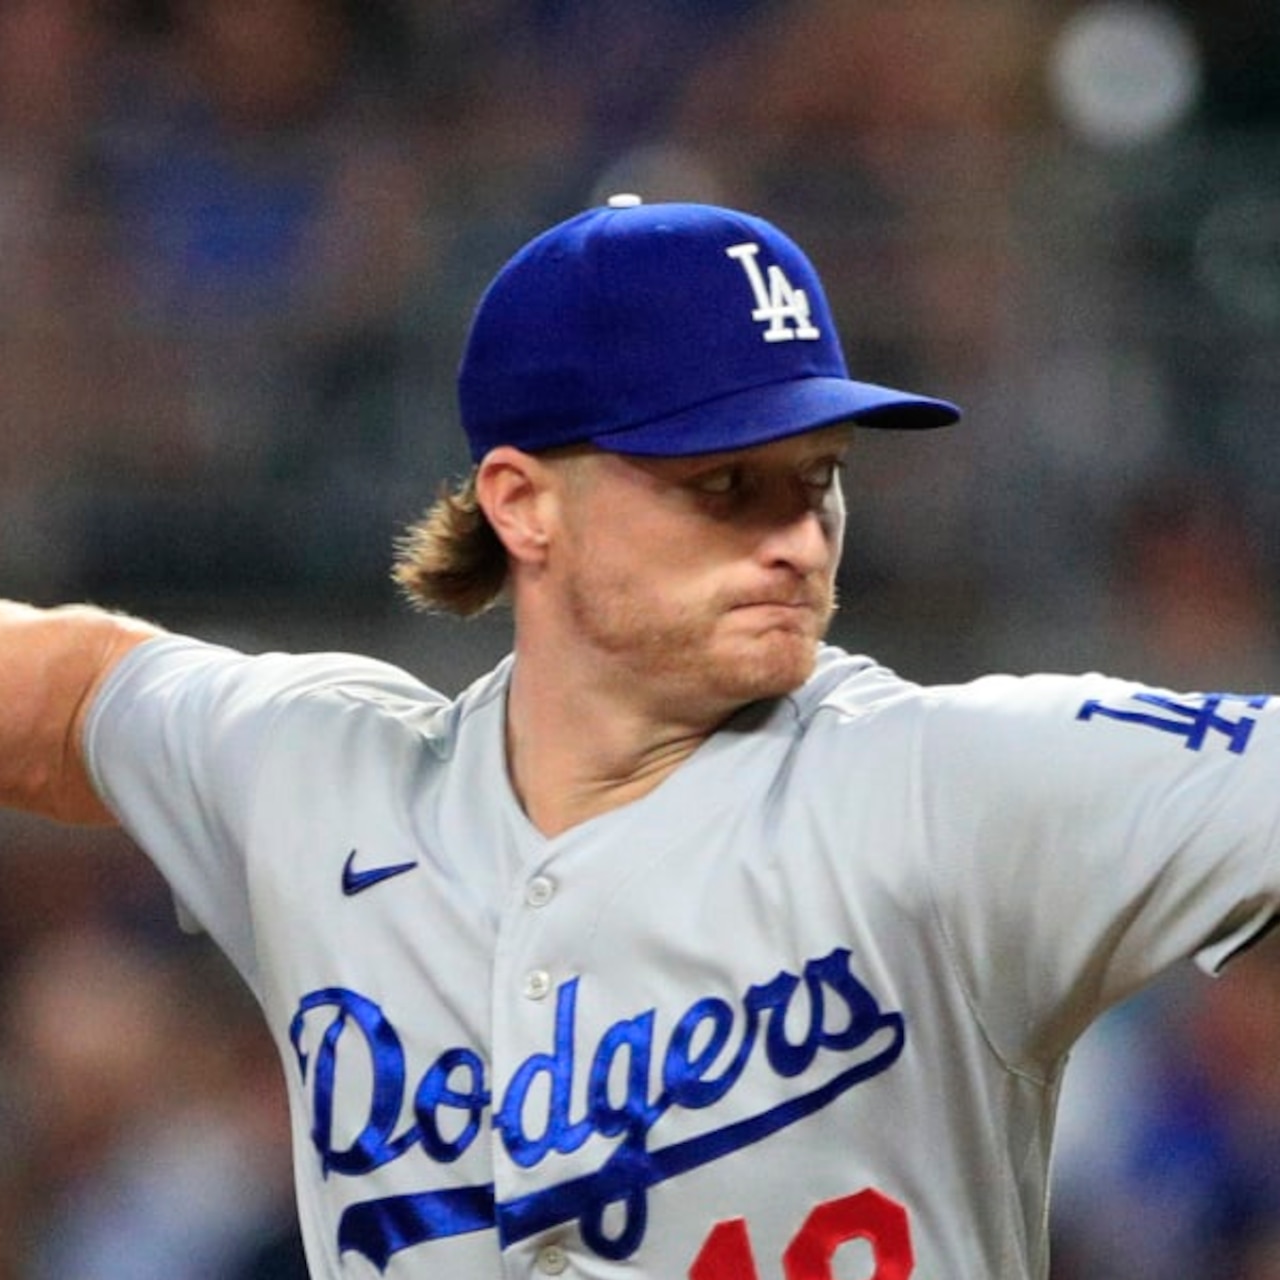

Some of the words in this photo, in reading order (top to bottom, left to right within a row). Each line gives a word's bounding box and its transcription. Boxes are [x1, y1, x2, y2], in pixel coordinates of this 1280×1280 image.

[725, 242, 820, 342] LA
[1075, 692, 1270, 755] LA
[290, 947, 906, 1261] Dodgers
